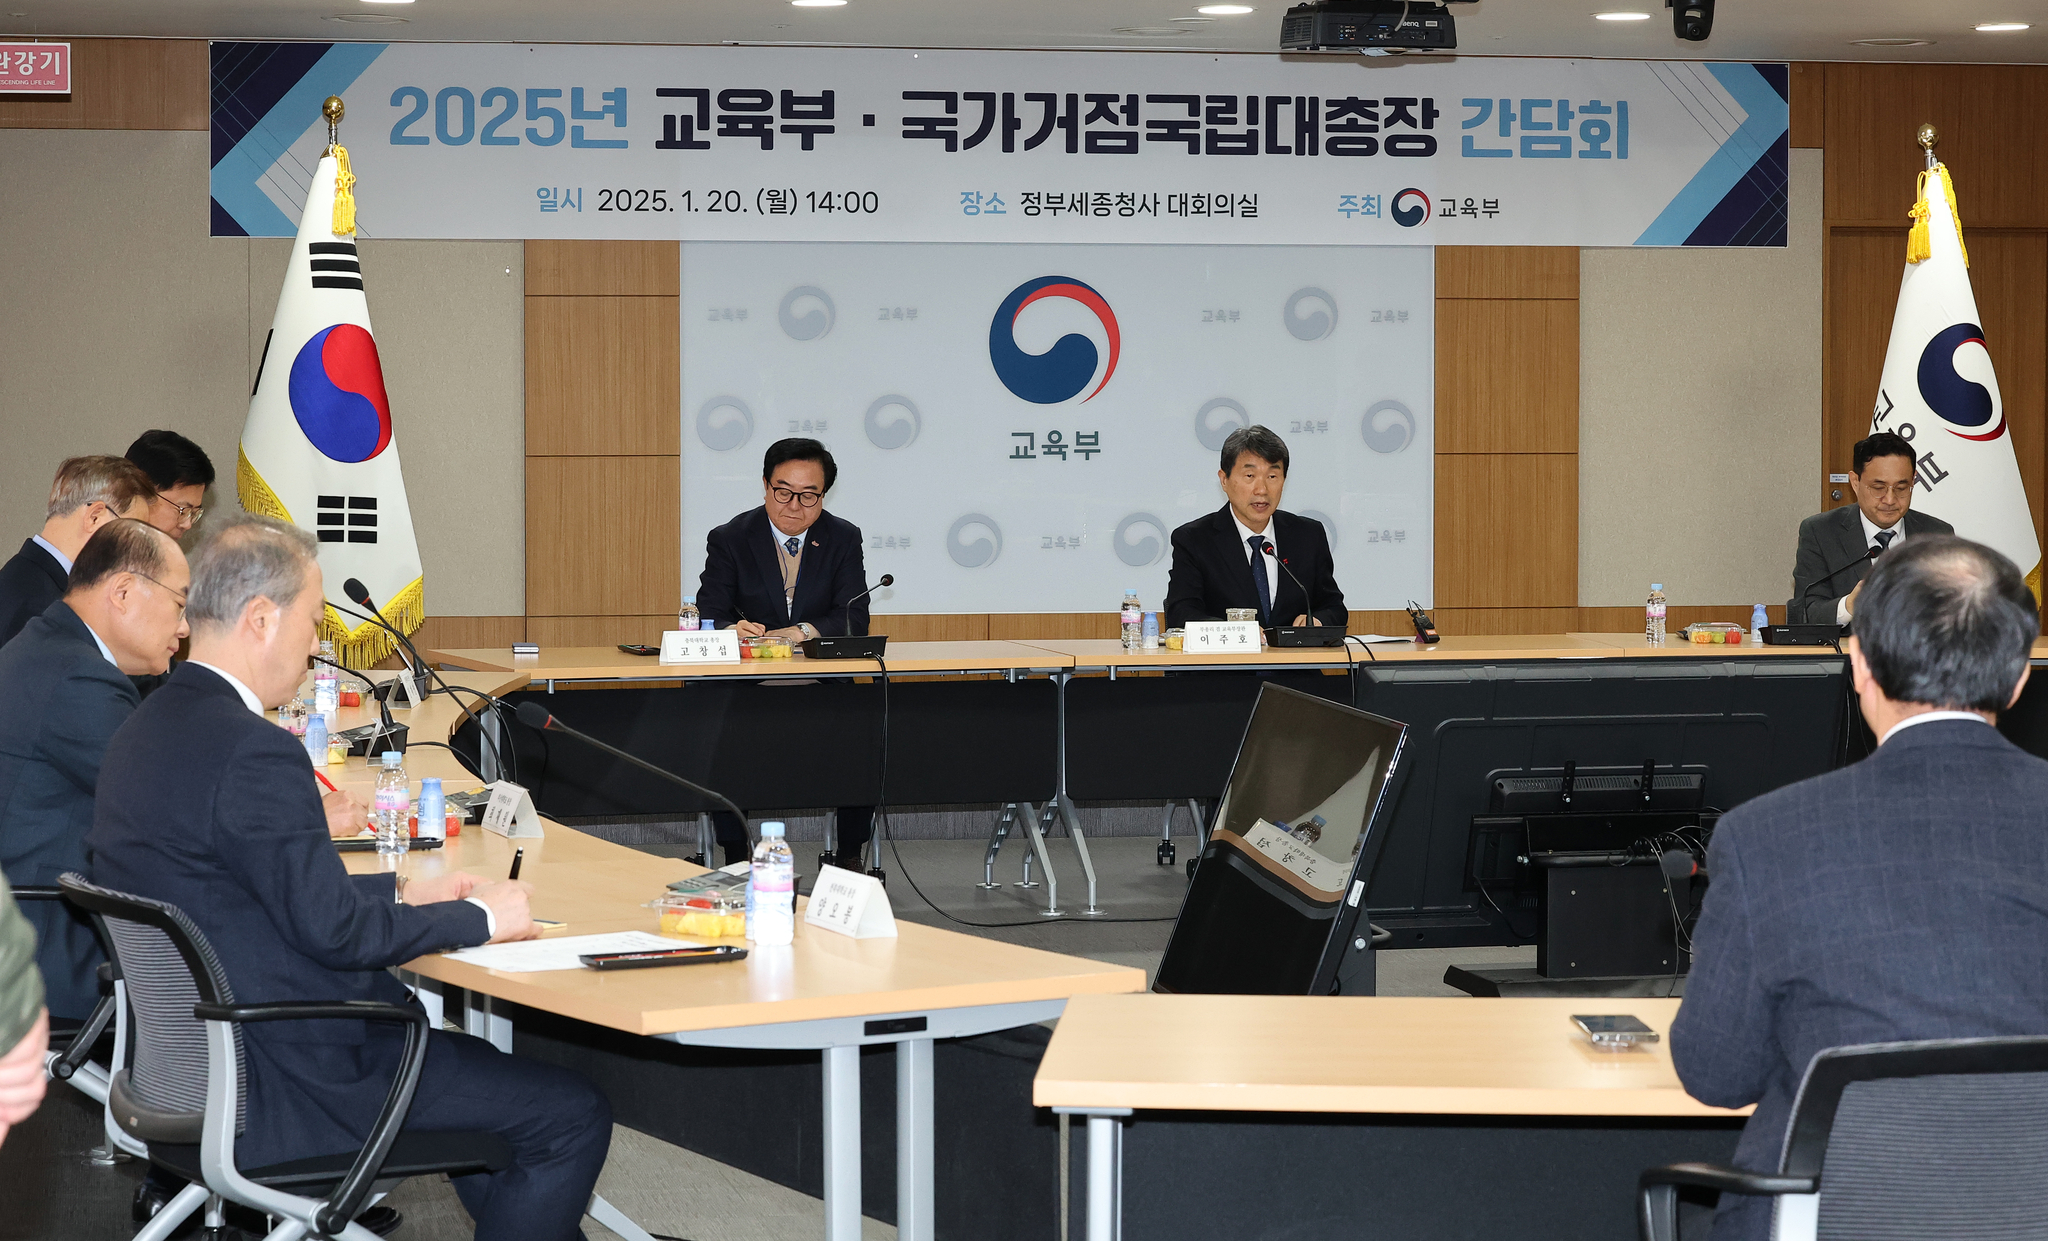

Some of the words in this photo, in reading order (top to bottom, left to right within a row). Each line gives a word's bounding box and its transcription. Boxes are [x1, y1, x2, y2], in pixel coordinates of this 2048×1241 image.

[390, 86, 628, 149] 2025년
[656, 88, 835, 150] 교육부
[902, 91, 1439, 157] 국가거점국립대총장
[1462, 98, 1630, 160] 간담회
[537, 187, 583, 213] 일시
[597, 188, 674, 213] 2025.
[681, 189, 699, 213] 1.
[707, 189, 748, 213] 20.
[756, 188, 798, 216] (월)
[805, 190, 879, 214] 14:00
[959, 190, 1007, 216] 장소
[1020, 191, 1161, 217] 정부세종청사
[1167, 193, 1259, 218] 대회의실
[1337, 194, 1382, 219] 주최
[1438, 197, 1500, 220] 교육부
[707, 308, 748, 321] 교육부
[878, 307, 918, 321] 교육부
[1201, 309, 1241, 323] 교육부
[1370, 309, 1409, 323] 교육부
[788, 420, 828, 433] 교육부
[1290, 420, 1329, 434] 교육부
[1009, 429, 1102, 462] 교육부
[870, 536, 911, 550] 교육부
[1041, 535, 1081, 549] 교육부
[1367, 529, 1406, 543] 교육부
